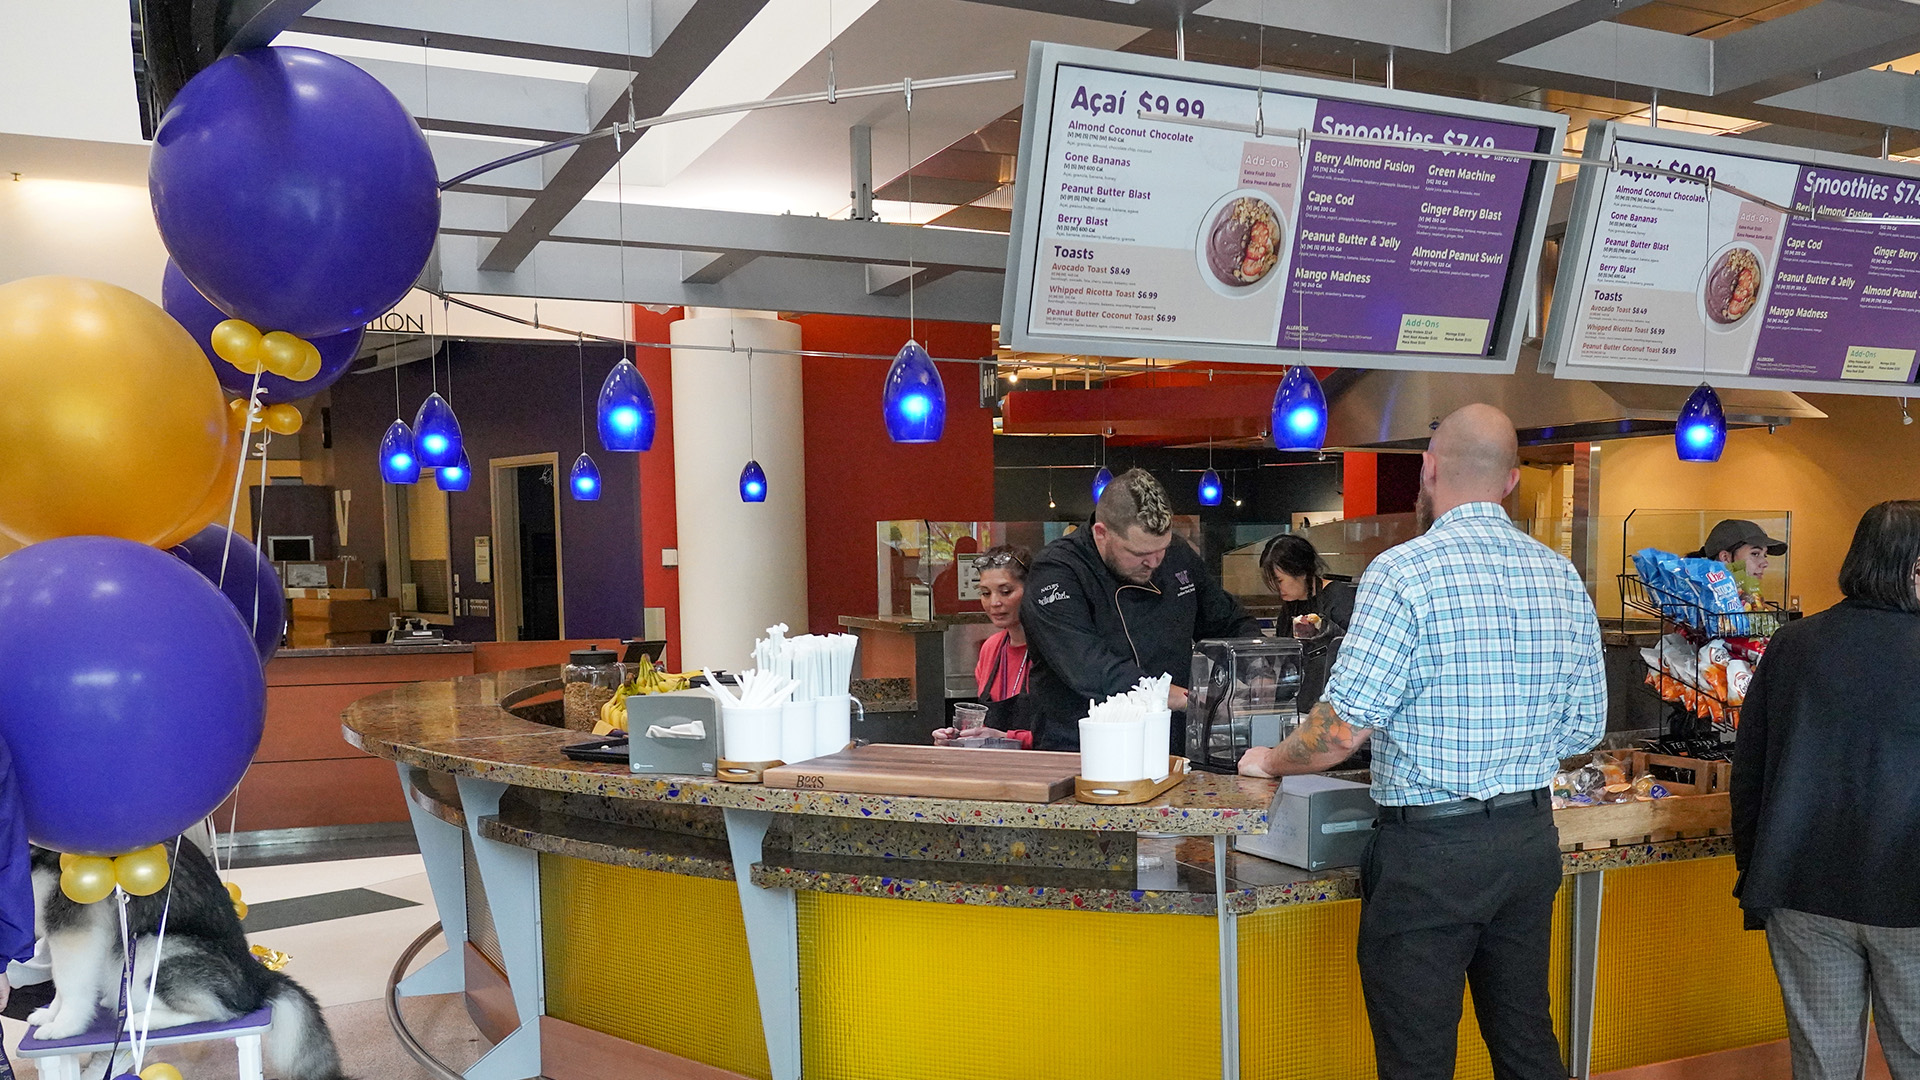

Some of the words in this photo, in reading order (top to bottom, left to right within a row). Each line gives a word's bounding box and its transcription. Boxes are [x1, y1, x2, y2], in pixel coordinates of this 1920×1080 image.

[1070, 86, 1128, 118] Açaí
[1068, 120, 1105, 132] Almond
[1108, 124, 1146, 137] Coconut
[1149, 129, 1193, 142] Chocolate
[1320, 116, 1434, 151] Smoothies
[1064, 151, 1088, 162] Gone
[1092, 154, 1130, 167] Bananas
[1245, 154, 1289, 168] Add-Ons
[1314, 151, 1341, 167] Berry
[1343, 154, 1382, 169] Almond
[1383, 159, 1415, 173] Fusion
[1428, 164, 1455, 178] Green
[1457, 168, 1496, 182] Machine
[1061, 182, 1093, 194] Peanut
[1096, 186, 1125, 197] Butter
[1128, 189, 1150, 200] Blast
[1616, 185, 1643, 195] Almond
[1644, 188, 1671, 198] Coconut
[1673, 191, 1706, 202] Chocolate
[1804, 171, 1890, 201] Smoothies
[1308, 190, 1332, 205] Cape
[1335, 193, 1354, 205] Cod
[1420, 202, 1452, 217] Ginger
[1452, 205, 1478, 221] Berry
[1478, 208, 1502, 221] Blast
[1610, 211, 1628, 220] Gone
[1629, 213, 1657, 224] Bananas
[1739, 212, 1772, 224] Add-Ons
[1057, 213, 1082, 226] Berry
[1085, 216, 1108, 226] Blast
[1301, 229, 1335, 242] Peanut
[1338, 232, 1368, 245] Butter
[1370, 235, 1376, 246] &
[1379, 236, 1401, 251] Jelly
[1604, 237, 1628, 247] Peanut
[1630, 239, 1651, 248] Butter
[1652, 241, 1669, 251] Blast
[1786, 237, 1805, 248] Cape
[1807, 239, 1823, 249] Cod
[1054, 245, 1093, 260] Toasts
[1411, 246, 1448, 259] Almond
[1448, 249, 1479, 262] Peanut
[1480, 252, 1503, 264] Swirl
[1873, 245, 1897, 259] Ginger
[1898, 248, 1918, 262] Berry
[1051, 262, 1084, 272] Avocado
[1087, 265, 1107, 273] Toast
[1109, 266, 1130, 275] $8.49
[1294, 267, 1327, 282] Mango
[1330, 270, 1371, 283] Madness
[1599, 263, 1617, 274] Berry
[1619, 264, 1636, 273] Blast
[1777, 271, 1804, 283] Peanut
[1805, 273, 1829, 284] Butter
[1830, 276, 1836, 285] &
[1837, 276, 1855, 289] Jelly
[1049, 285, 1084, 295] Whipped
[1086, 287, 1112, 296] Ricotta
[1116, 289, 1135, 298] Toast
[1137, 290, 1158, 299] $6.99
[1594, 290, 1622, 301] Toasts
[1862, 285, 1892, 296] Almond
[1892, 287, 1917, 298] Peanut
[1046, 307, 1072, 316] Peanut
[1075, 309, 1099, 317] Butter
[1101, 310, 1132, 320] Coconut
[1135, 313, 1154, 321] Toast
[1156, 313, 1176, 322] $6.99
[1632, 306, 1647, 314] $8.49
[1768, 305, 1794, 318] Mango
[1795, 307, 1828, 319] Madness
[1404, 318, 1439, 328] Add-Ons
[1650, 327, 1665, 335] $6.99
